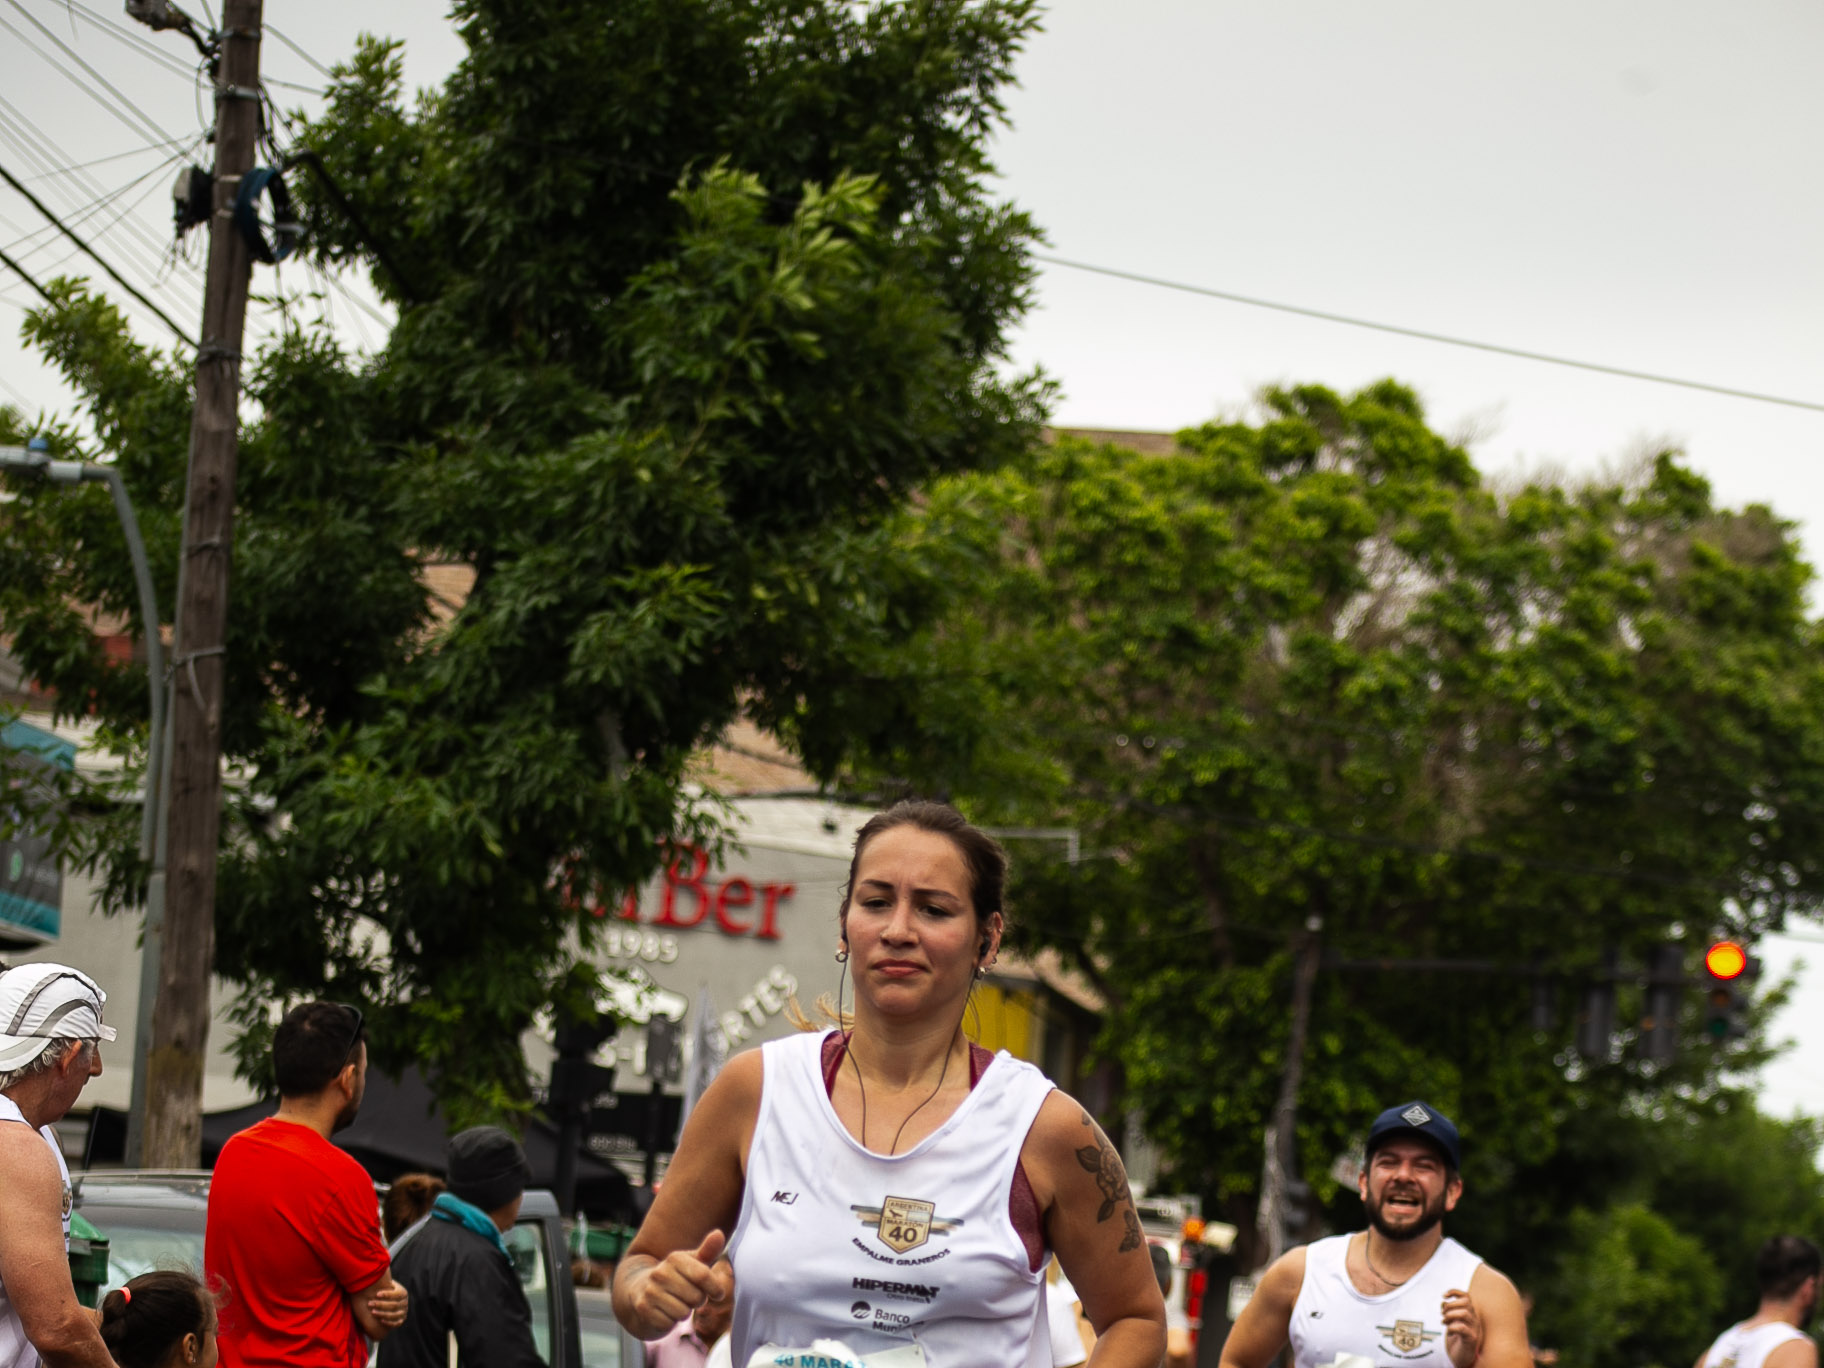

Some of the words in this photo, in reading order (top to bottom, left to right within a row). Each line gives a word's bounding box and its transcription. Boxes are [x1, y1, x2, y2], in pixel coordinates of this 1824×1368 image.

[888, 1226, 918, 1243] 40
[852, 1237, 894, 1265] EMPALME
[896, 1248, 951, 1266] GRANEROS
[875, 1308, 910, 1324] Banco
[773, 1353, 794, 1367] 40
